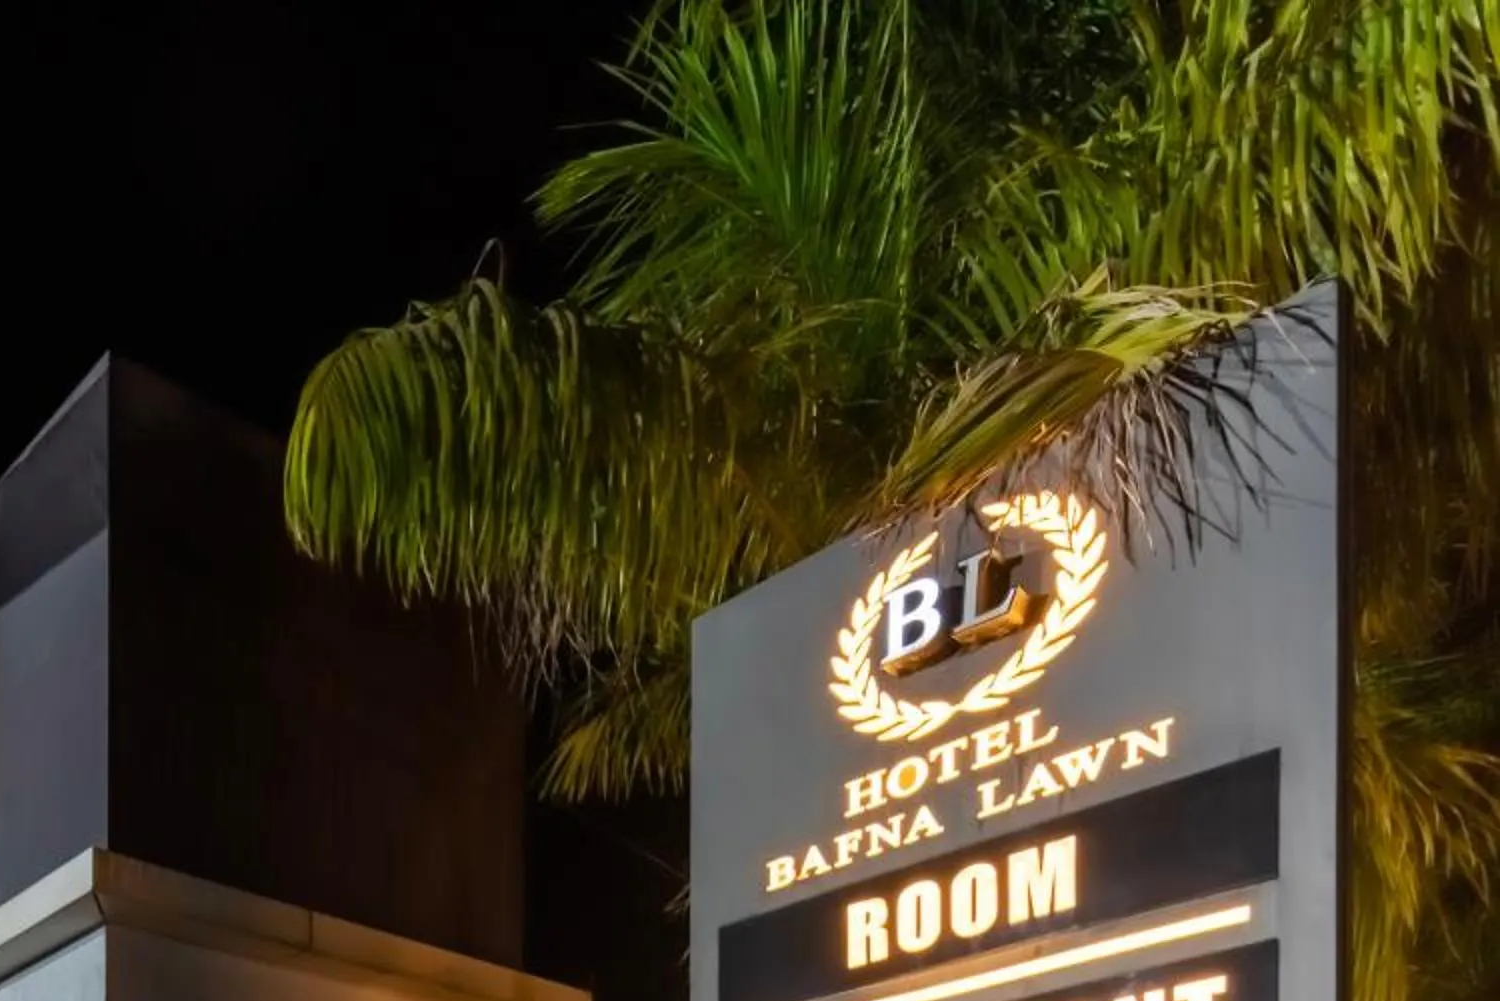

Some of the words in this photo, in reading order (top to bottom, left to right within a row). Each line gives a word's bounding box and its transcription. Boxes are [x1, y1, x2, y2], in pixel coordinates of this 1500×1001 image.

[766, 805, 945, 892] BAFNA
[976, 717, 1177, 821] LAWN
[844, 709, 1060, 819] HOTEL
[846, 835, 1078, 970] ROOM
